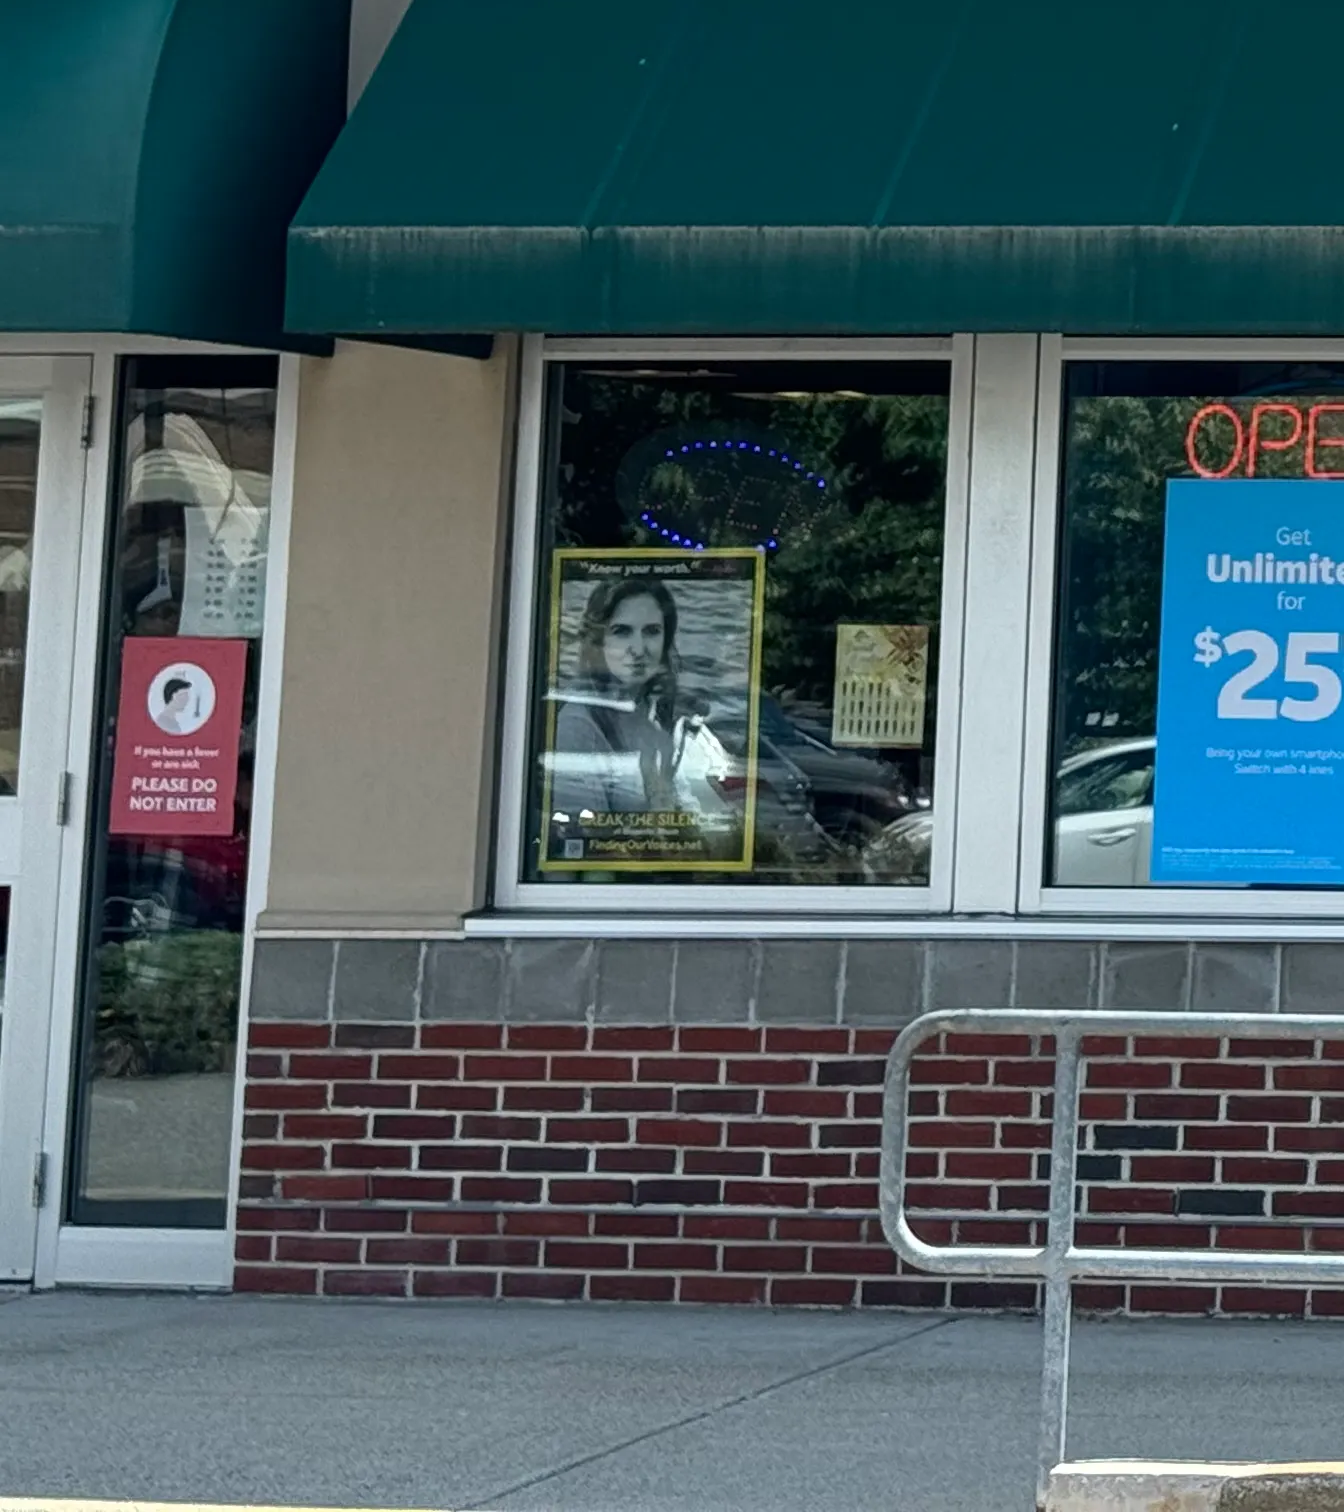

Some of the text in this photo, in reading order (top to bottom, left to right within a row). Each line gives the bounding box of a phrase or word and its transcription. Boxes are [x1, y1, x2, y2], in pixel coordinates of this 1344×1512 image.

[1276, 526, 1313, 547] Get
[1277, 591, 1306, 611] for
[1193, 626, 1343, 722] $25
[1237, 748, 1262, 761] your
[1263, 749, 1288, 759] own
[131, 776, 218, 793] PLEASE DO
[129, 795, 217, 813] NOT ENTER
[627, 813, 654, 827] THE
